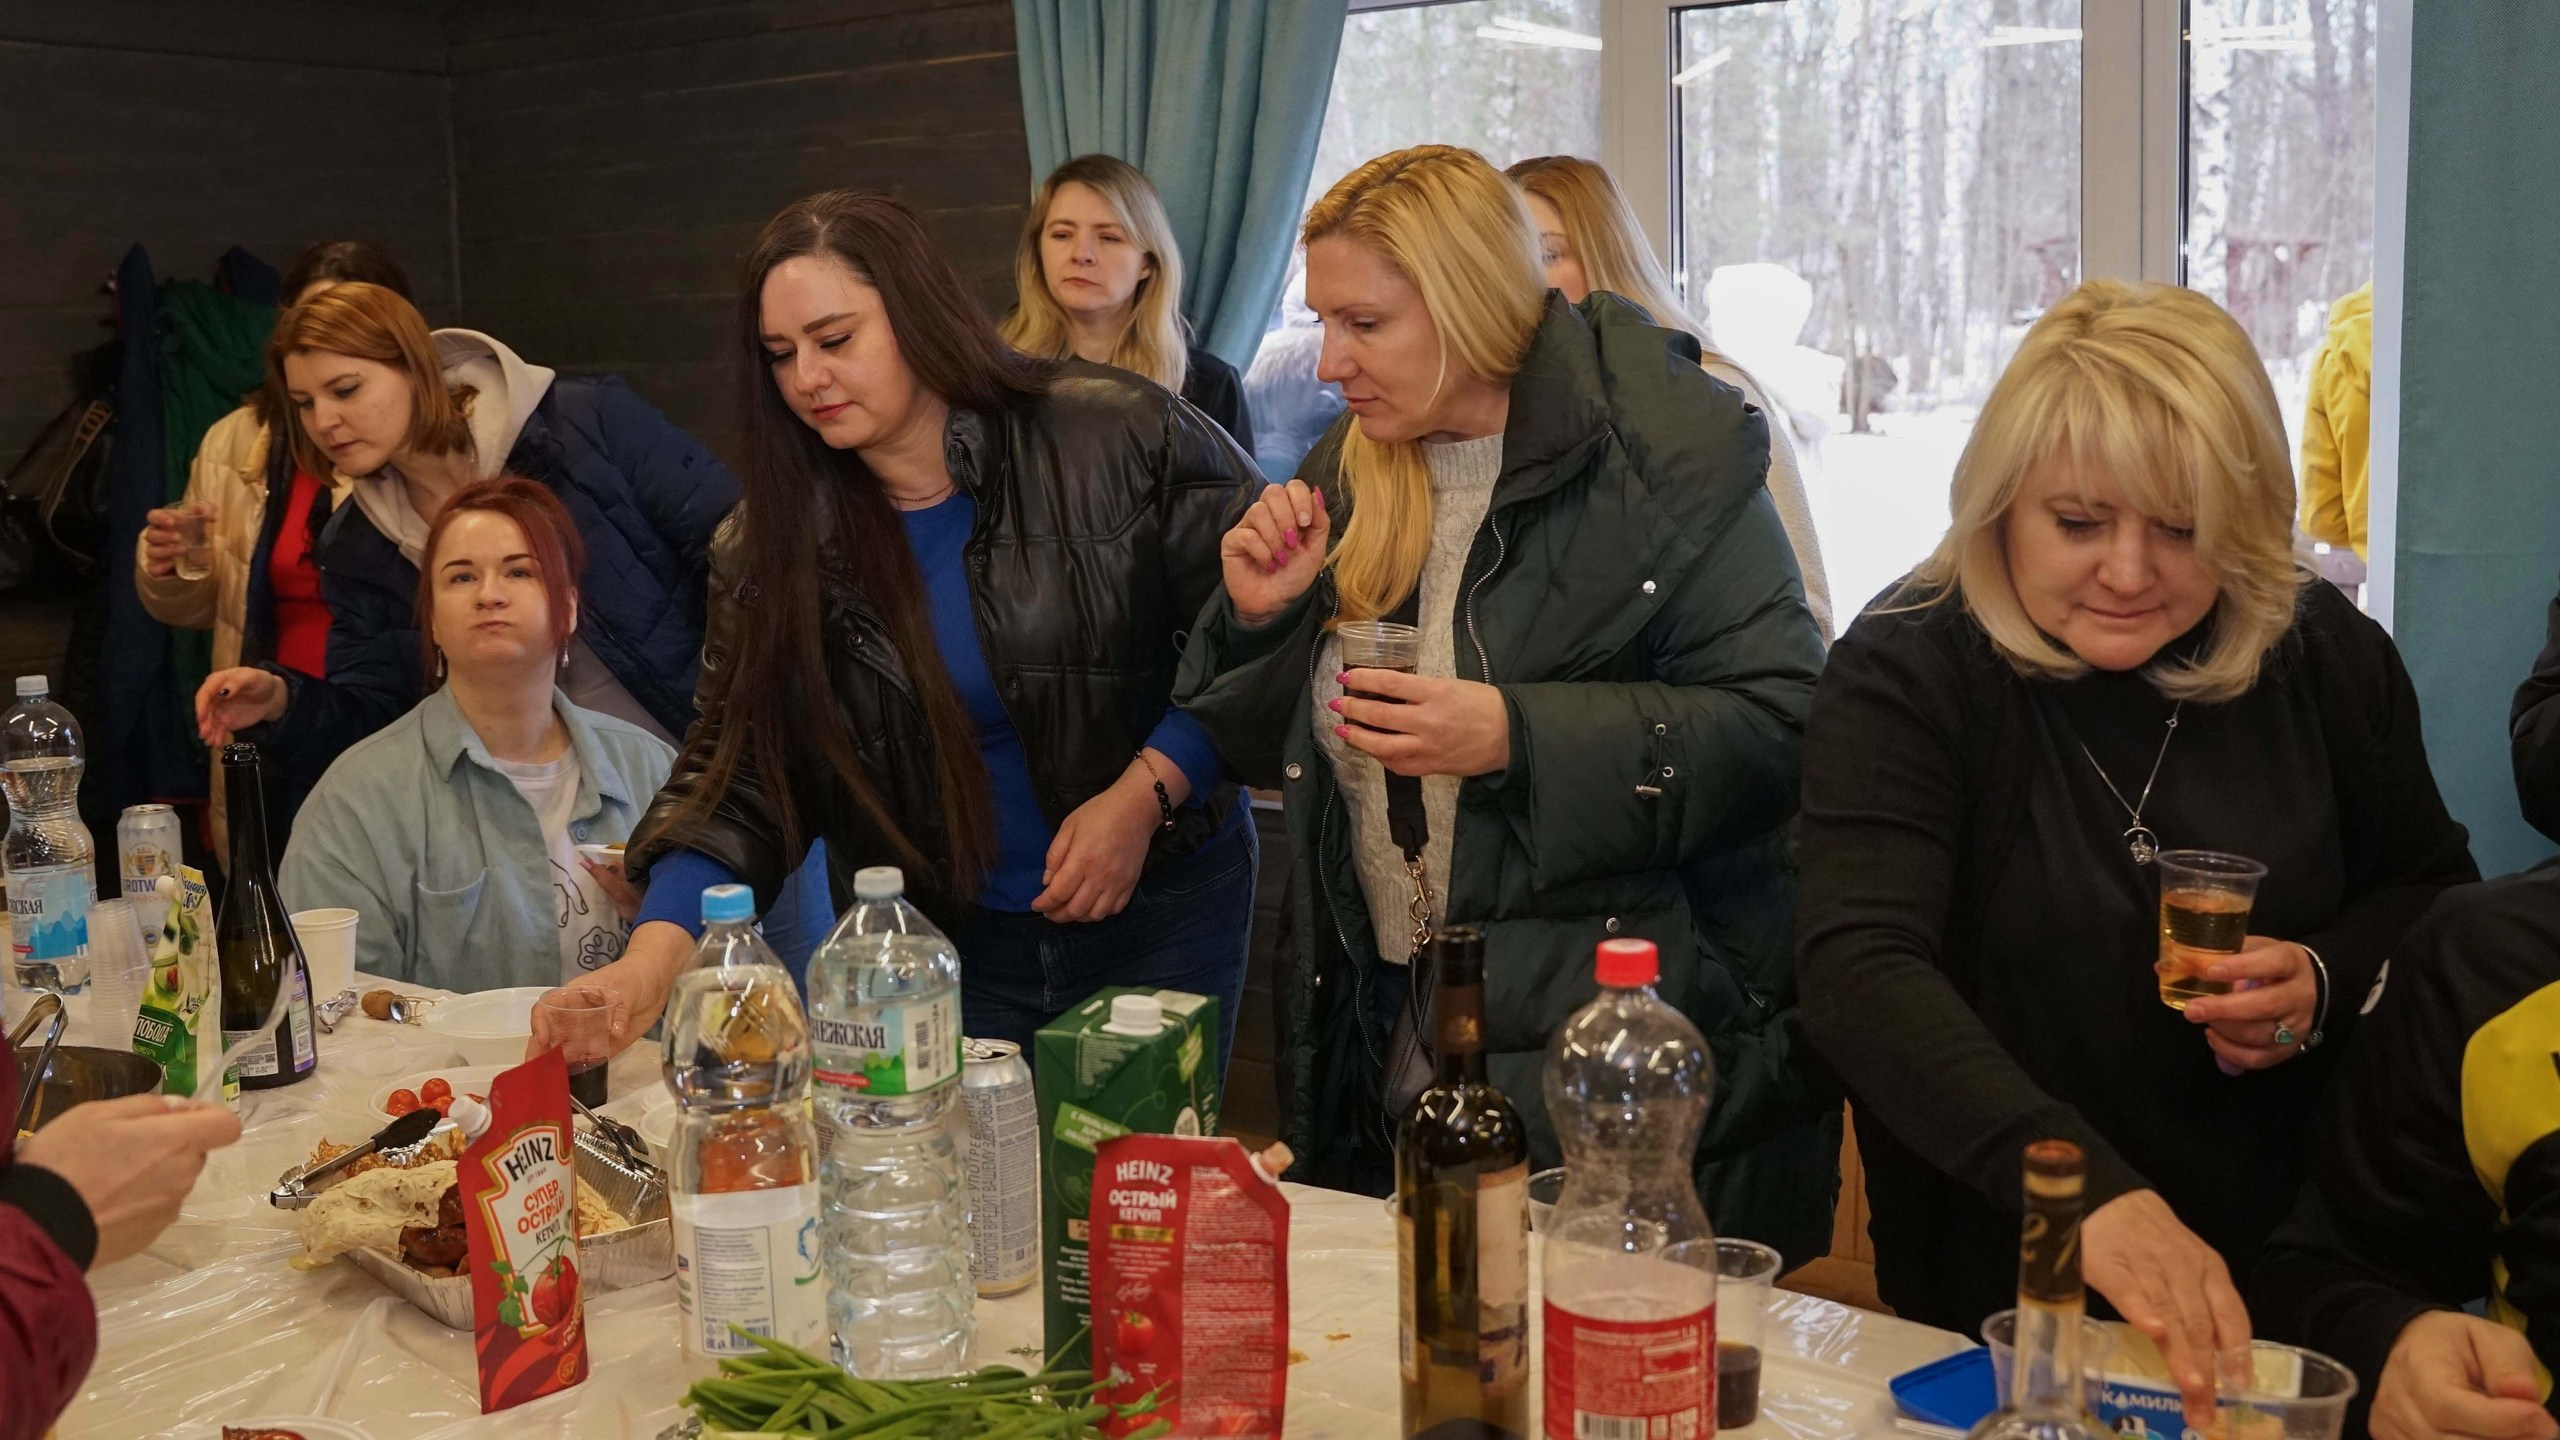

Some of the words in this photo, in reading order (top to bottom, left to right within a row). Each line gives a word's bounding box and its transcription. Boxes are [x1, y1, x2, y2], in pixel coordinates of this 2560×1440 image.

[504, 1137, 555, 1182] HEINZ
[1115, 1160, 1174, 1186] HEINZ
[517, 1190, 565, 1234] ОСТРЫЙ
[523, 1179, 559, 1212] СУПЕР
[982, 1193, 998, 1230] ВРЕДИТ
[1108, 1189, 1177, 1209] ОСТРЫЙ
